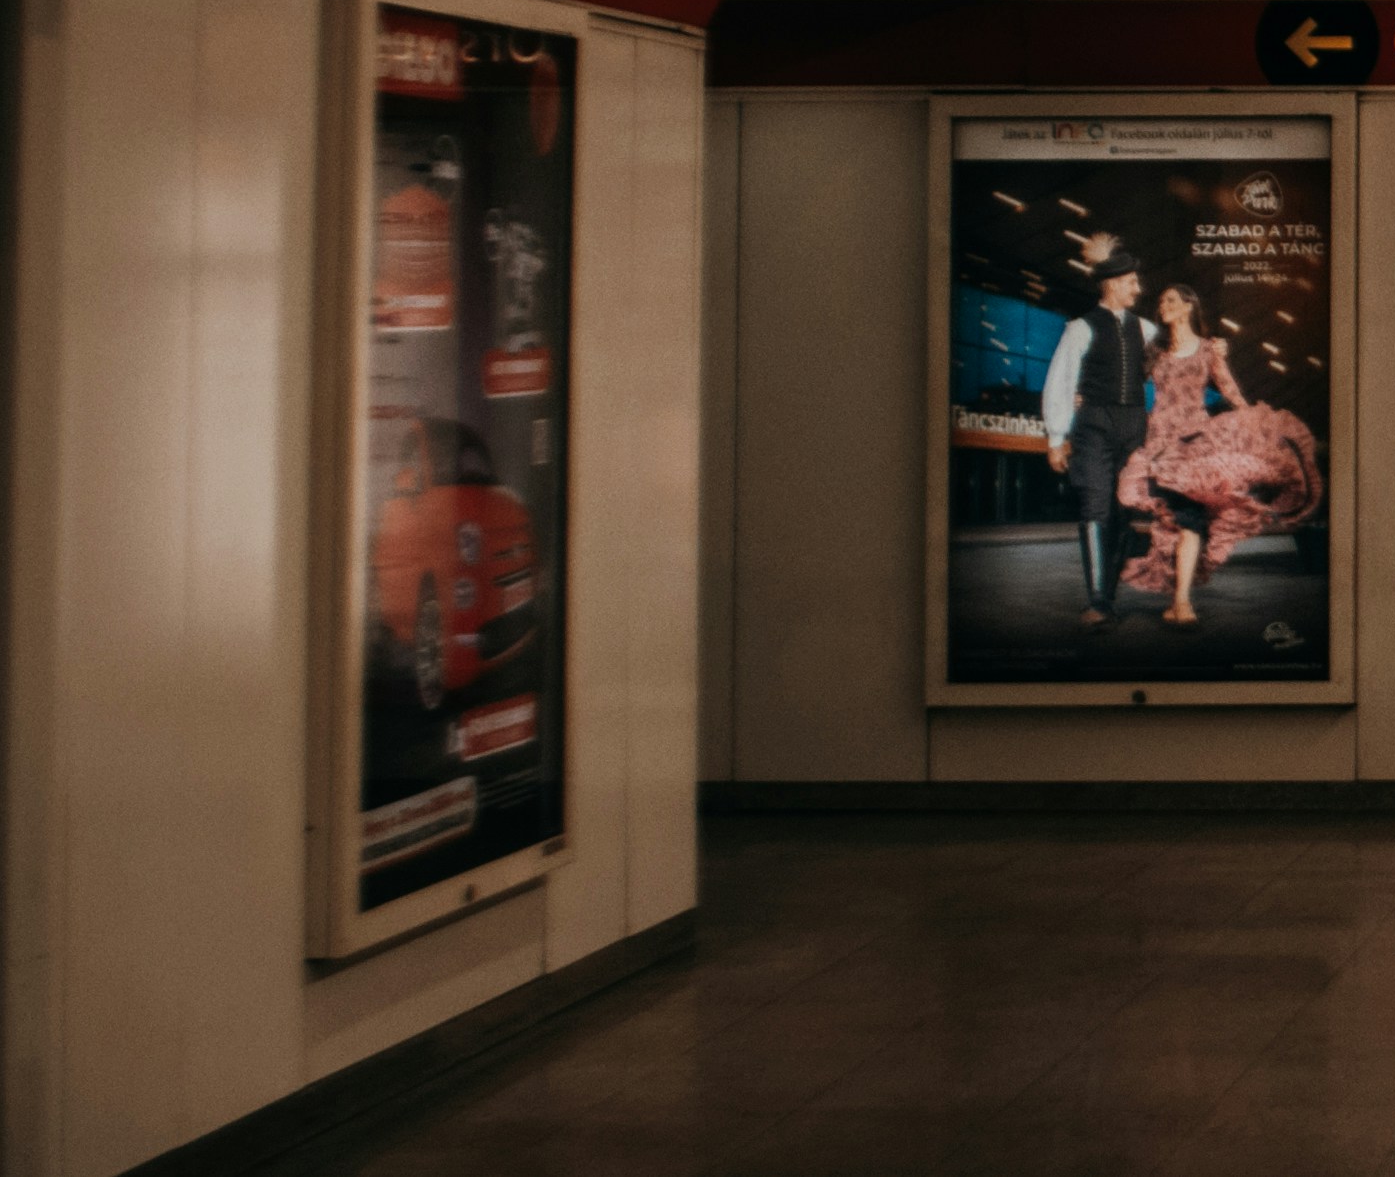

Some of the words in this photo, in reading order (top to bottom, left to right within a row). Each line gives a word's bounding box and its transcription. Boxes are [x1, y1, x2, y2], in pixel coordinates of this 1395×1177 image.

[1195, 224, 1266, 237] SZABAD
[1268, 225, 1281, 237] A
[1191, 243, 1261, 256] SZABAD
[1264, 243, 1277, 256] A
